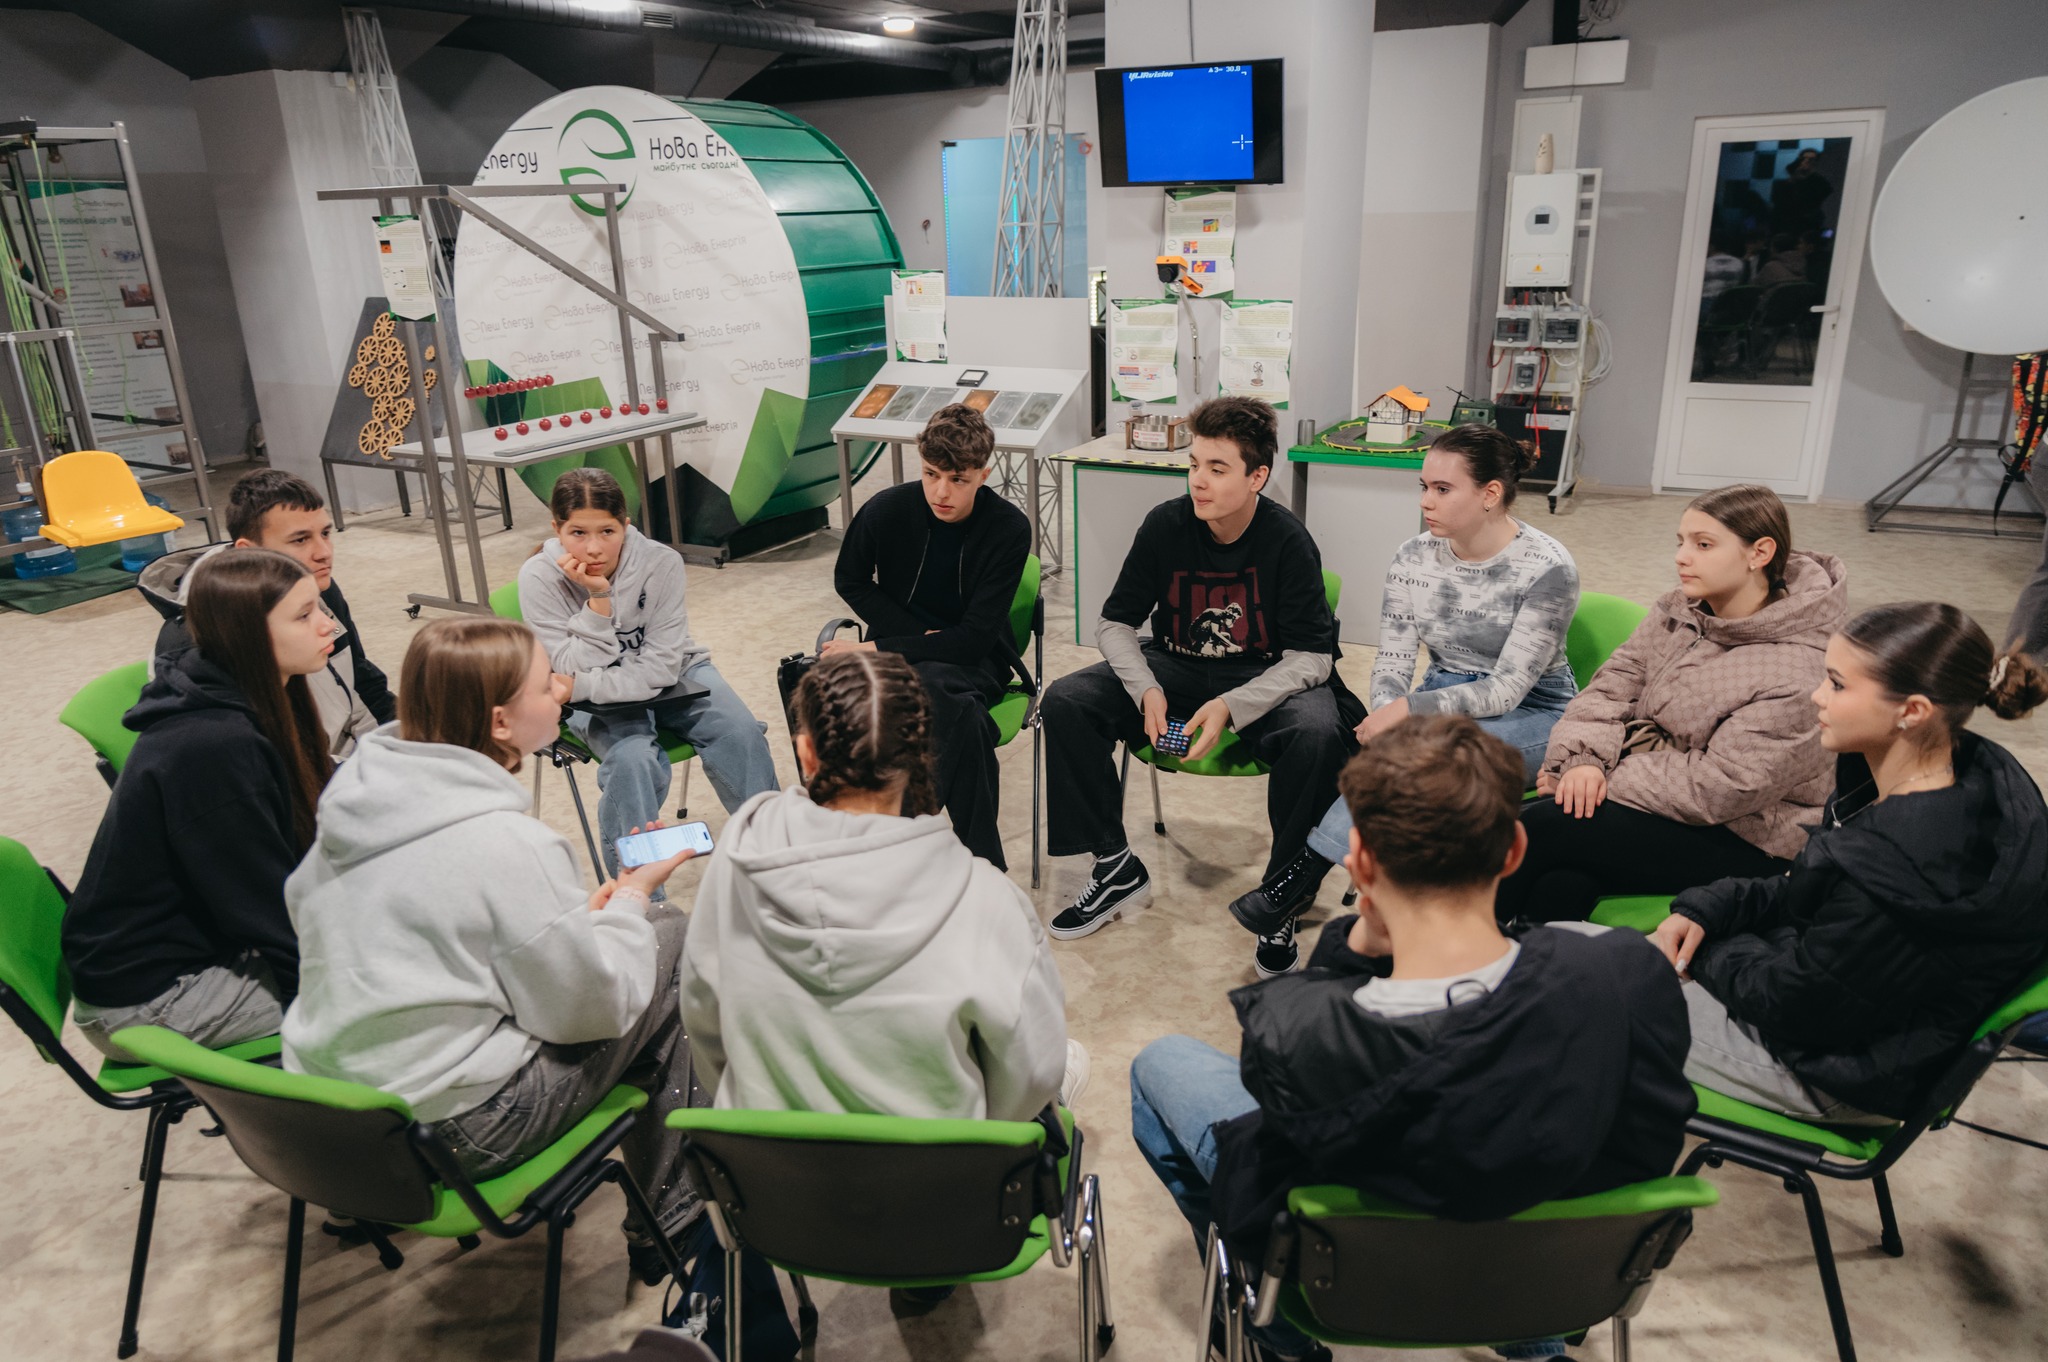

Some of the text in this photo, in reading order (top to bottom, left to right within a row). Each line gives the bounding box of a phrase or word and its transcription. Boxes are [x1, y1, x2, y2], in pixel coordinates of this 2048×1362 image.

[705, 134, 735, 157] Ен
[653, 159, 739, 173] майбутнє сьогодні
[622, 255, 653, 269] nergy
[673, 286, 710, 300] Energy
[502, 316, 534, 330] Energy
